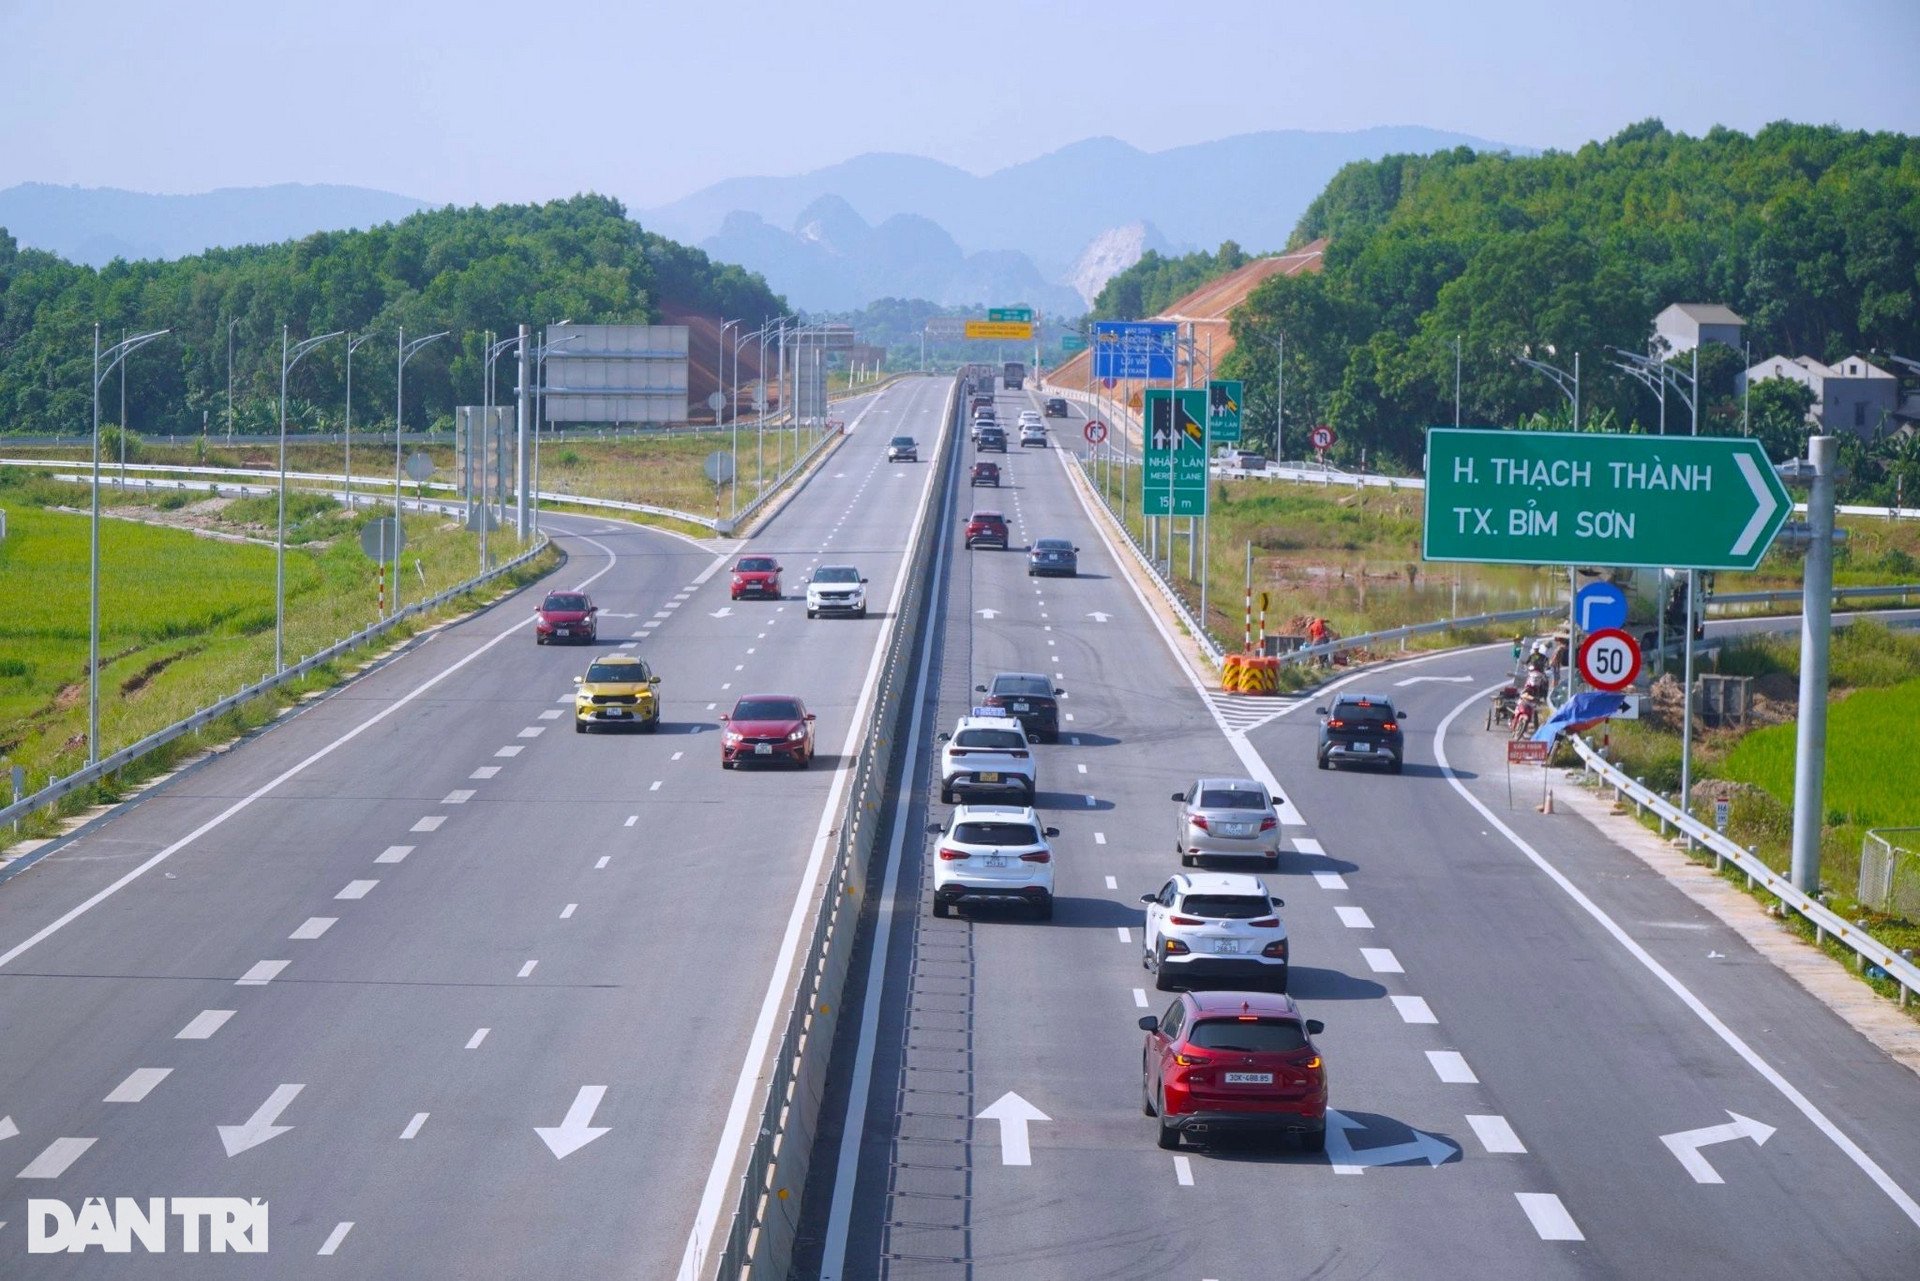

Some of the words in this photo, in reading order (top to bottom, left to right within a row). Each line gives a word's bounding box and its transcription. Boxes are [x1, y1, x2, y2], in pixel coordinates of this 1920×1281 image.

[1180, 472, 1202, 481] LANE
[1453, 456, 1479, 484] H.
[1490, 458, 1591, 491] THẠCH
[1608, 454, 1712, 491] THÀNH
[1181, 499, 1192, 508] m
[1453, 507, 1498, 535] TX.
[1508, 498, 1558, 537] BỈM
[1575, 509, 1636, 539] SƠN
[1596, 648, 1623, 675] 50
